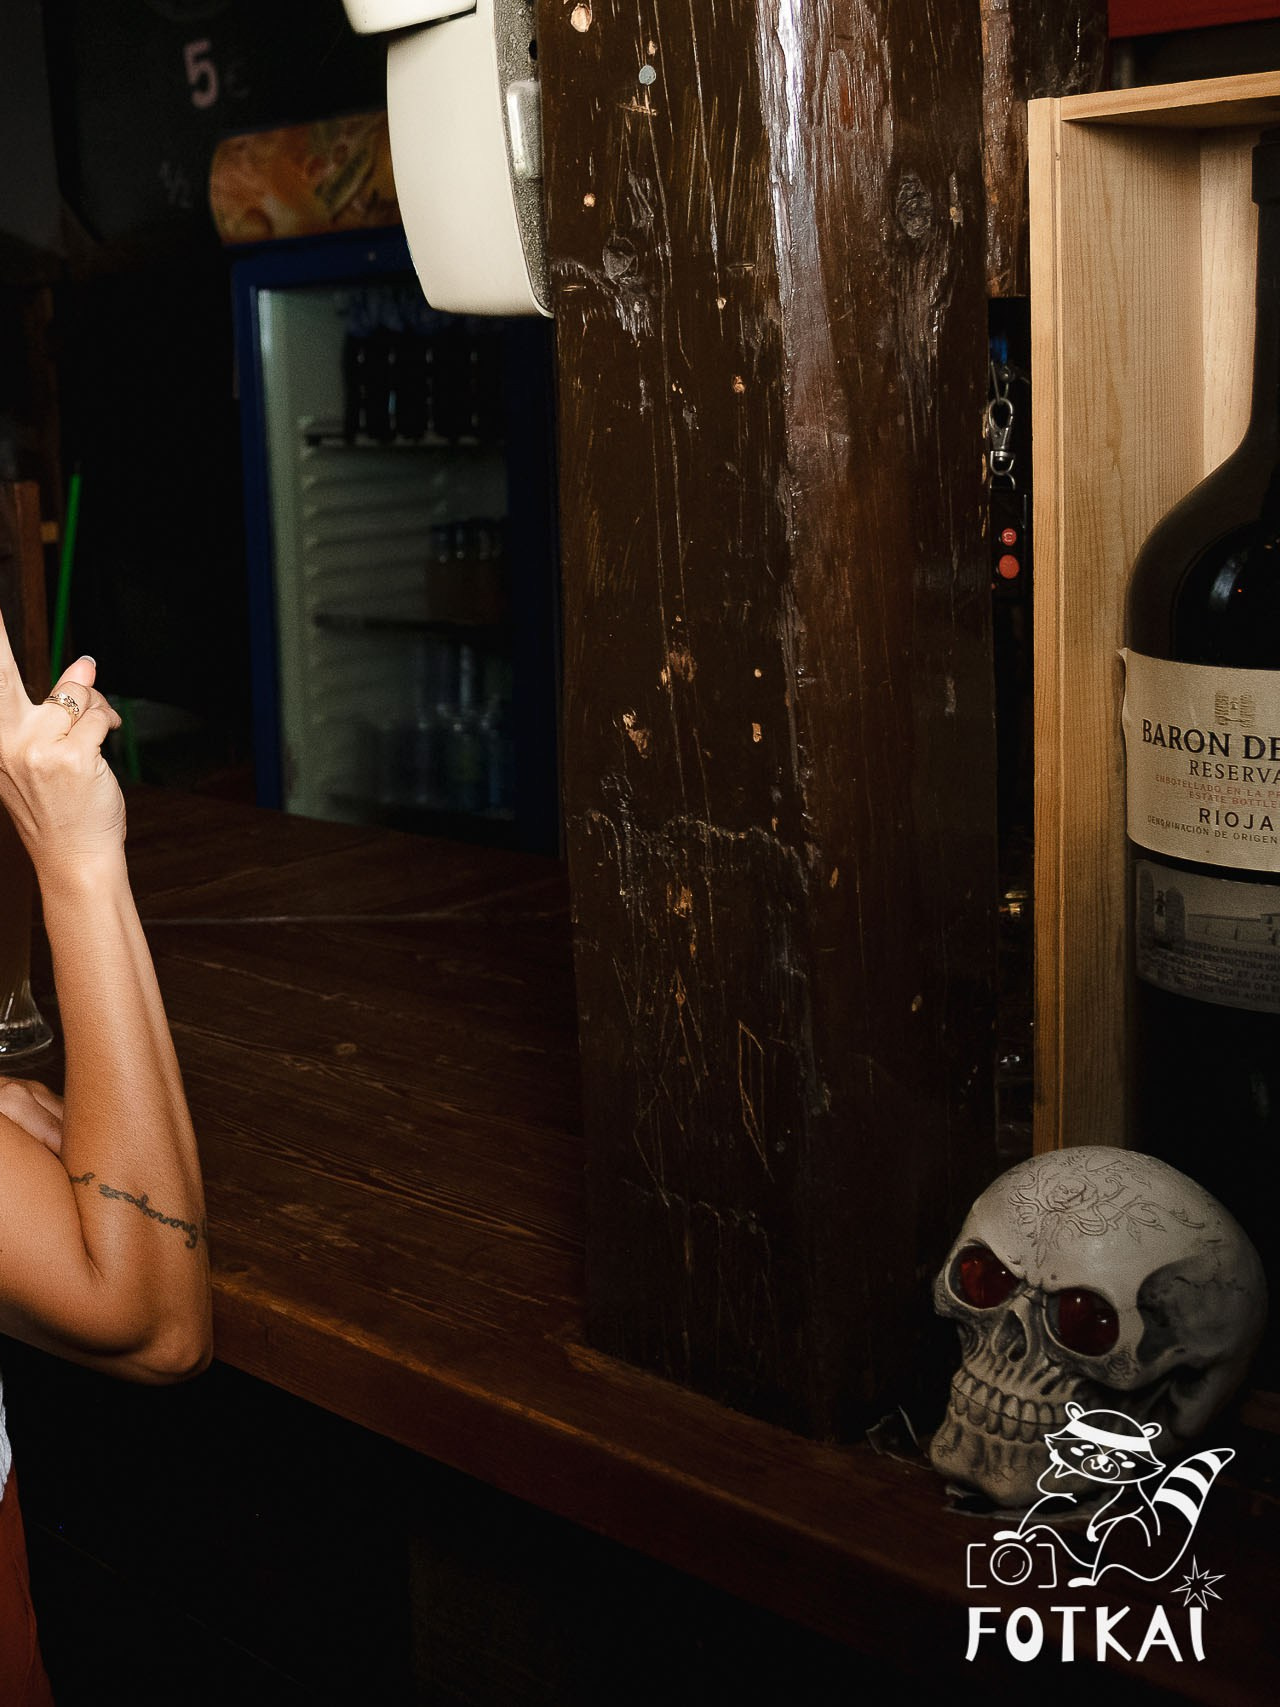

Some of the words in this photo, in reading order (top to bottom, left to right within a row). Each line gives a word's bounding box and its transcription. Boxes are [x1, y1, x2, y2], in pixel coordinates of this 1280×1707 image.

[183, 38, 219, 110] 5
[1142, 718, 1232, 757] BARON
[1155, 774, 1221, 793] EMBOTELLADO
[1227, 786, 1240, 795] EN
[1247, 788, 1262, 798] LA
[1189, 790, 1227, 804] ESTATE
[1199, 807, 1274, 832] RIOJA
[1214, 829, 1228, 839] DE
[1233, 832, 1278, 845] ORIGEN
